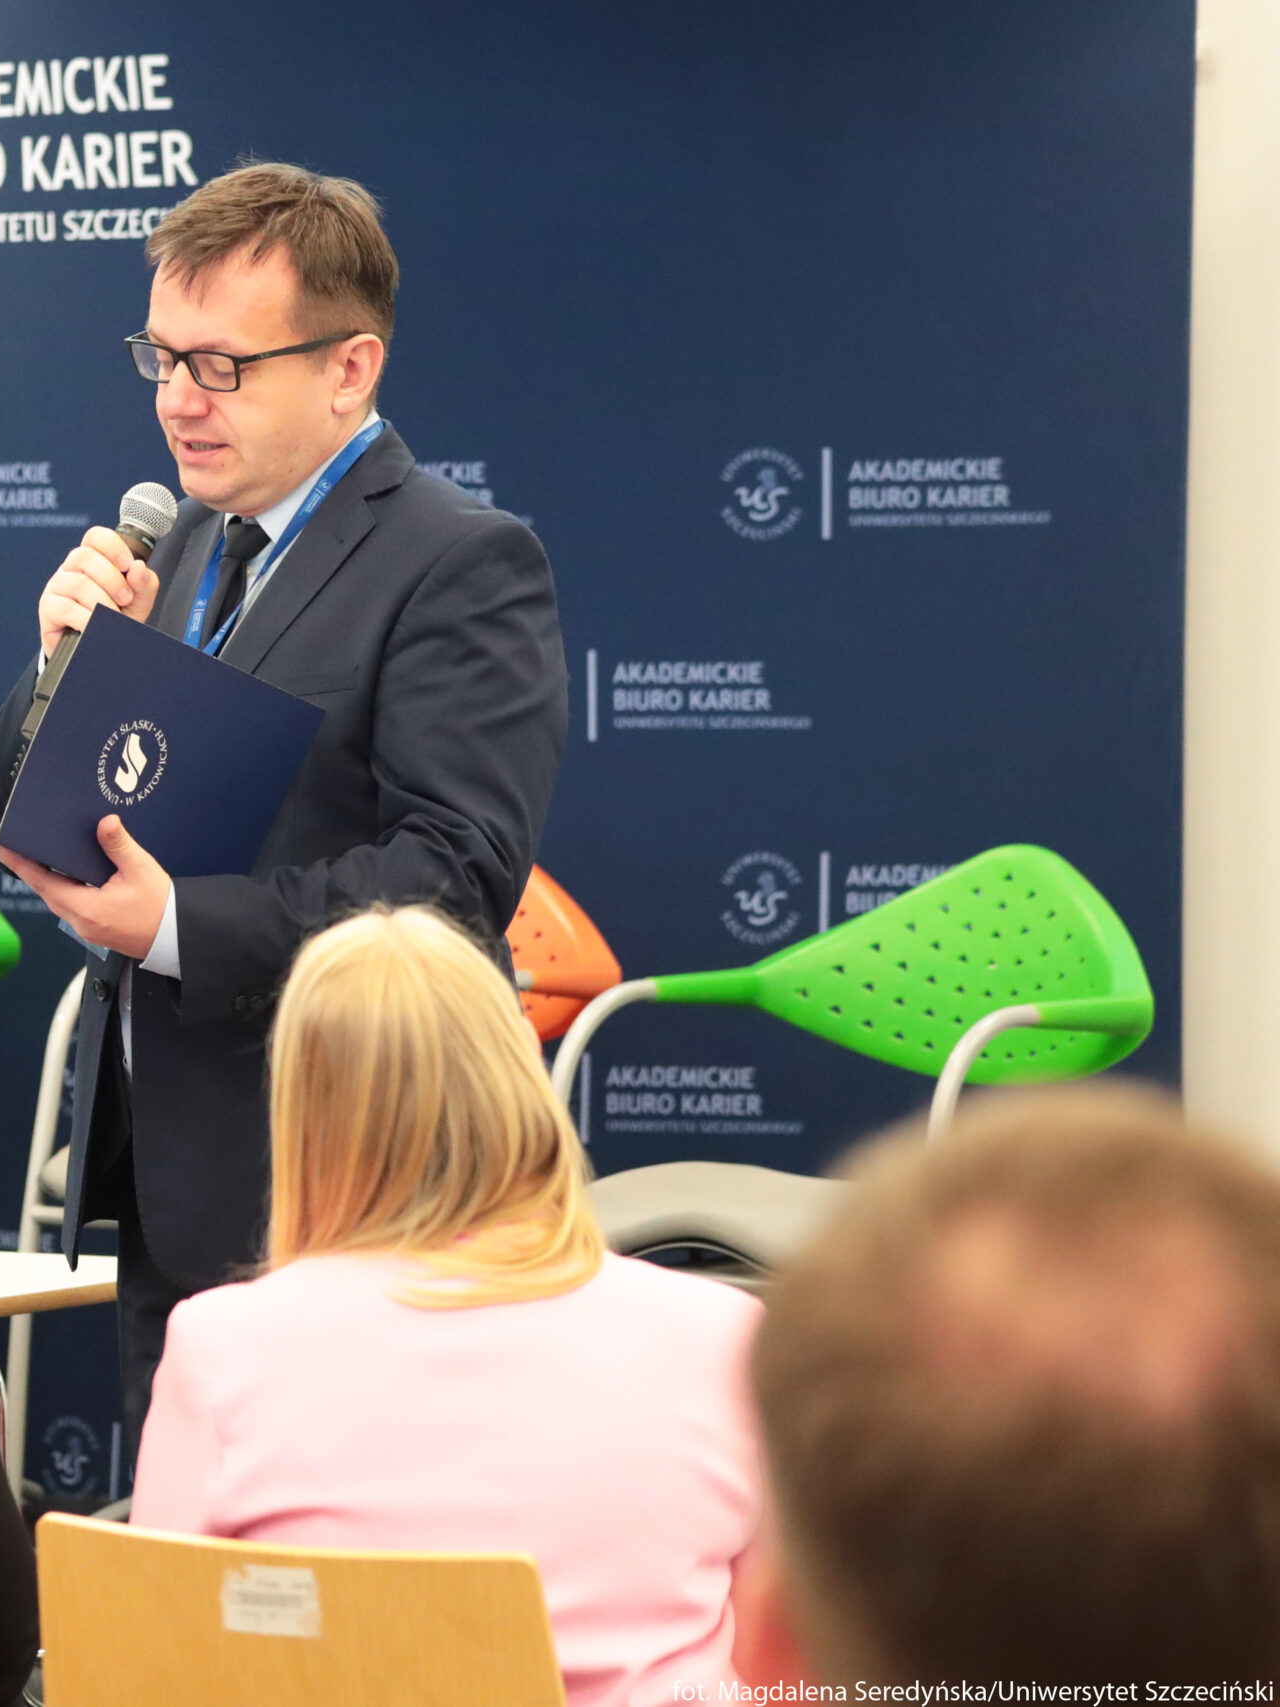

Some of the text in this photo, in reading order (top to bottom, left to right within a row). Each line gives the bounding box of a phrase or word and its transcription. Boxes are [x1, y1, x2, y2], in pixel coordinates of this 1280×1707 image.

[21, 130, 198, 192] KARIER
[63, 206, 176, 241] SZCZEC
[848, 457, 1003, 481] AKADEMICKIE
[849, 484, 1010, 509] BIURO KARIER
[613, 661, 764, 684] AKADEMICKIE
[613, 688, 771, 711] BIURO KARIER
[605, 1066, 755, 1089] AKADEMICKIE
[606, 1092, 763, 1116] BIURO KARIER
